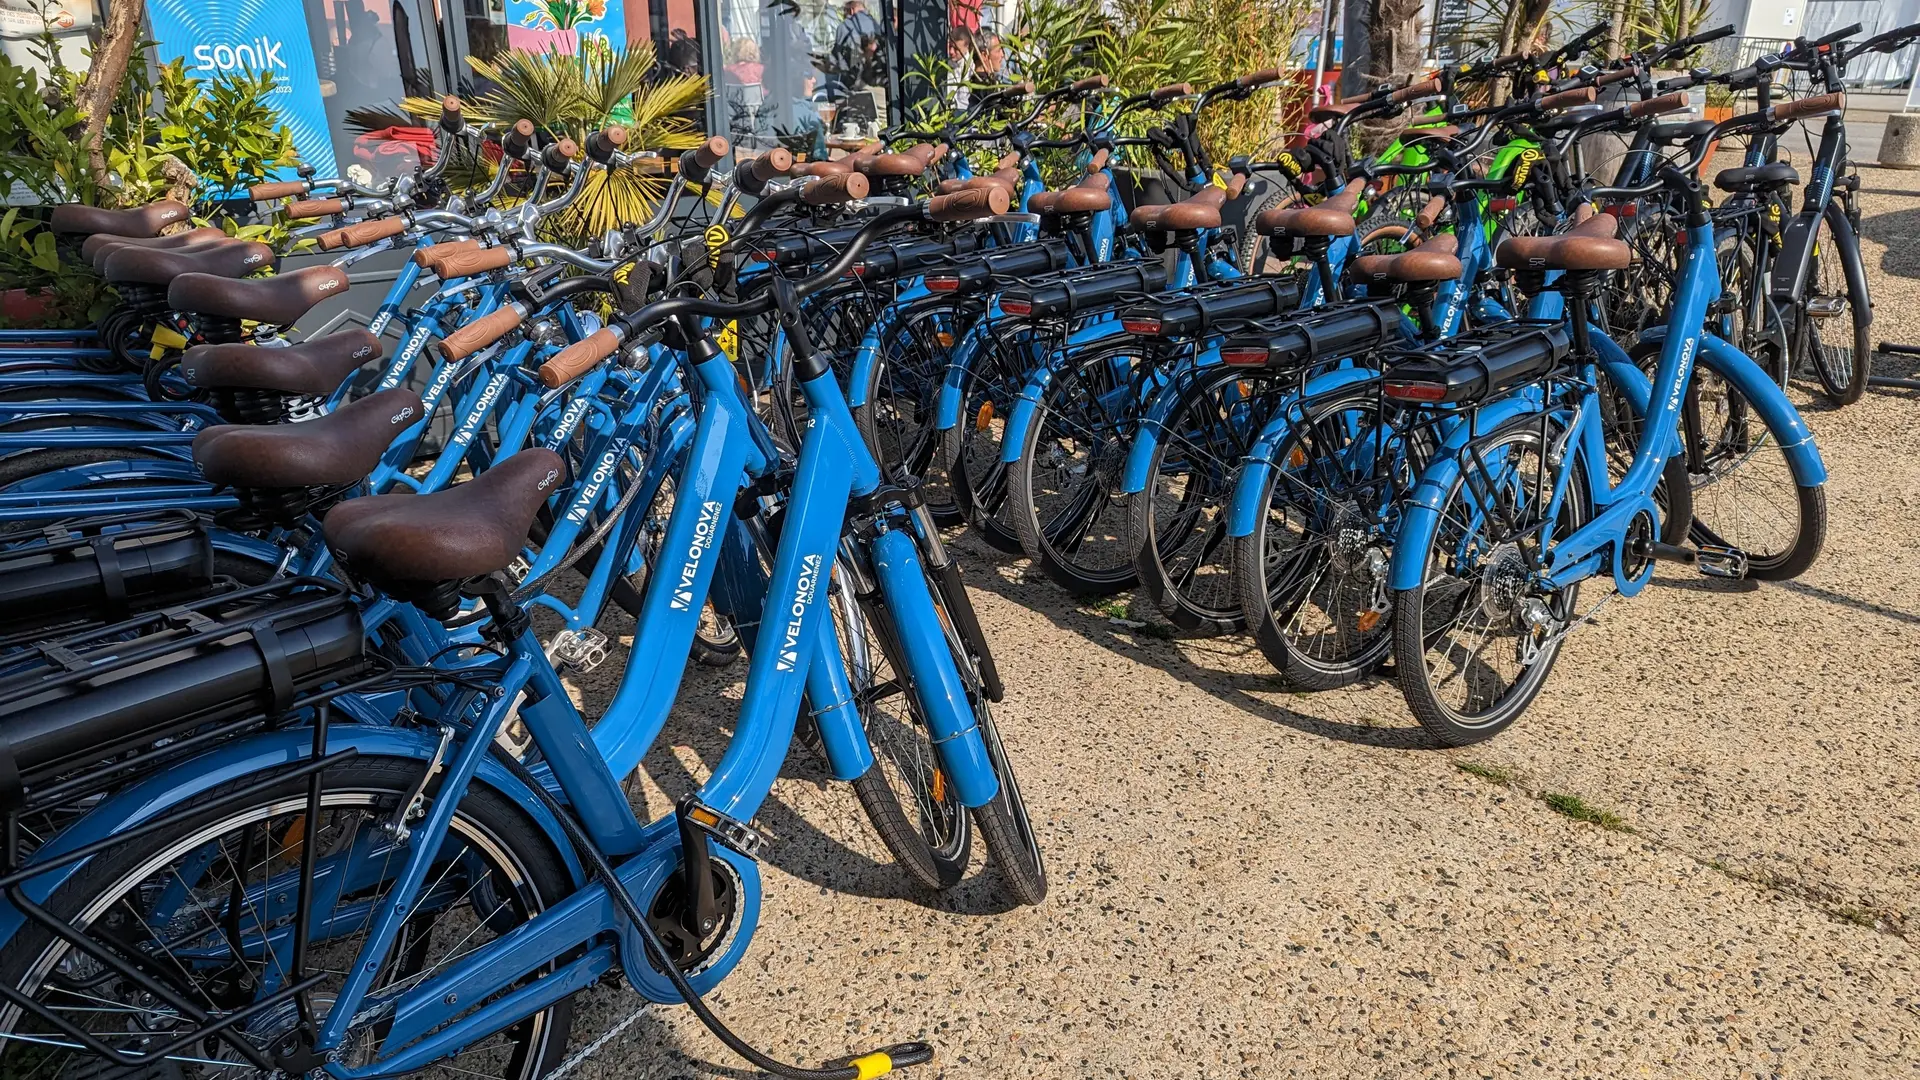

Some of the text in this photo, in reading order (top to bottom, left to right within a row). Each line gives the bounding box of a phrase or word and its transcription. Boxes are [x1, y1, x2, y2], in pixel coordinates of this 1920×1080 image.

[193, 36, 287, 70] sonik
[275, 85, 292, 93] 2023
[390, 326, 428, 378] VELONOVA
[1672, 337, 1694, 398] VELONOVA
[463, 373, 505, 429] VELONOVA
[546, 398, 586, 452] ELONOVA
[567, 401, 590, 435] DOUARNENEZ
[807, 418, 816, 428] 12
[578, 436, 627, 508] VELONOVA
[607, 440, 632, 477] DOUARNENEZ
[679, 500, 716, 589] VELONOVA
[704, 501, 723, 550] DOUARNENEZ
[783, 553, 817, 649] VELONOVA
[806, 554, 823, 606] DOUARNENEZ
